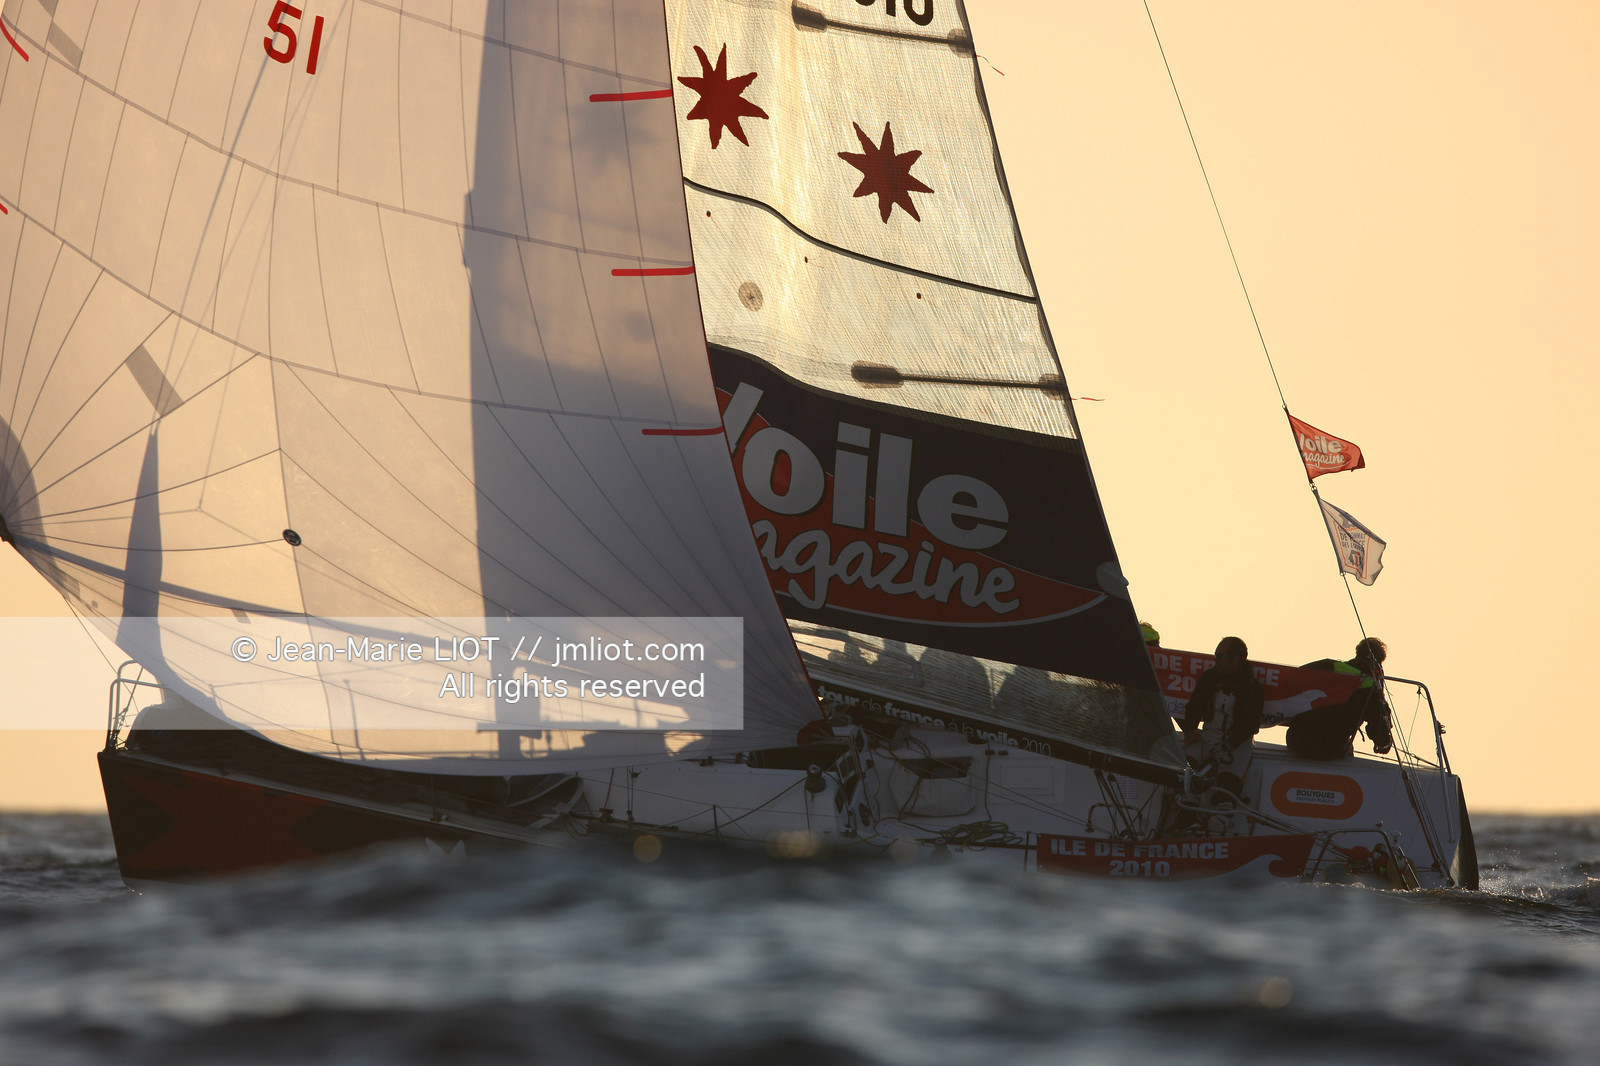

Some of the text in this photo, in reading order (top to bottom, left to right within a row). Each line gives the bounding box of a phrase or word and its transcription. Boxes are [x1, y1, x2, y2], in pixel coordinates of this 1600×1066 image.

[263, 0, 324, 75] 51
[752, 519, 1020, 614] agazine
[1153, 653, 1183, 673] DE
[1167, 674, 1197, 693] 20
[862, 698, 882, 713] de
[884, 701, 945, 728] france
[976, 729, 1019, 747] voile
[1022, 737, 1052, 757] 2010
[1262, 712, 1287, 724] voil
[1296, 789, 1336, 800] BOUYGUES
[1051, 838, 1229, 860] ILE DE FRANCE
[1109, 860, 1170, 878] 2010
